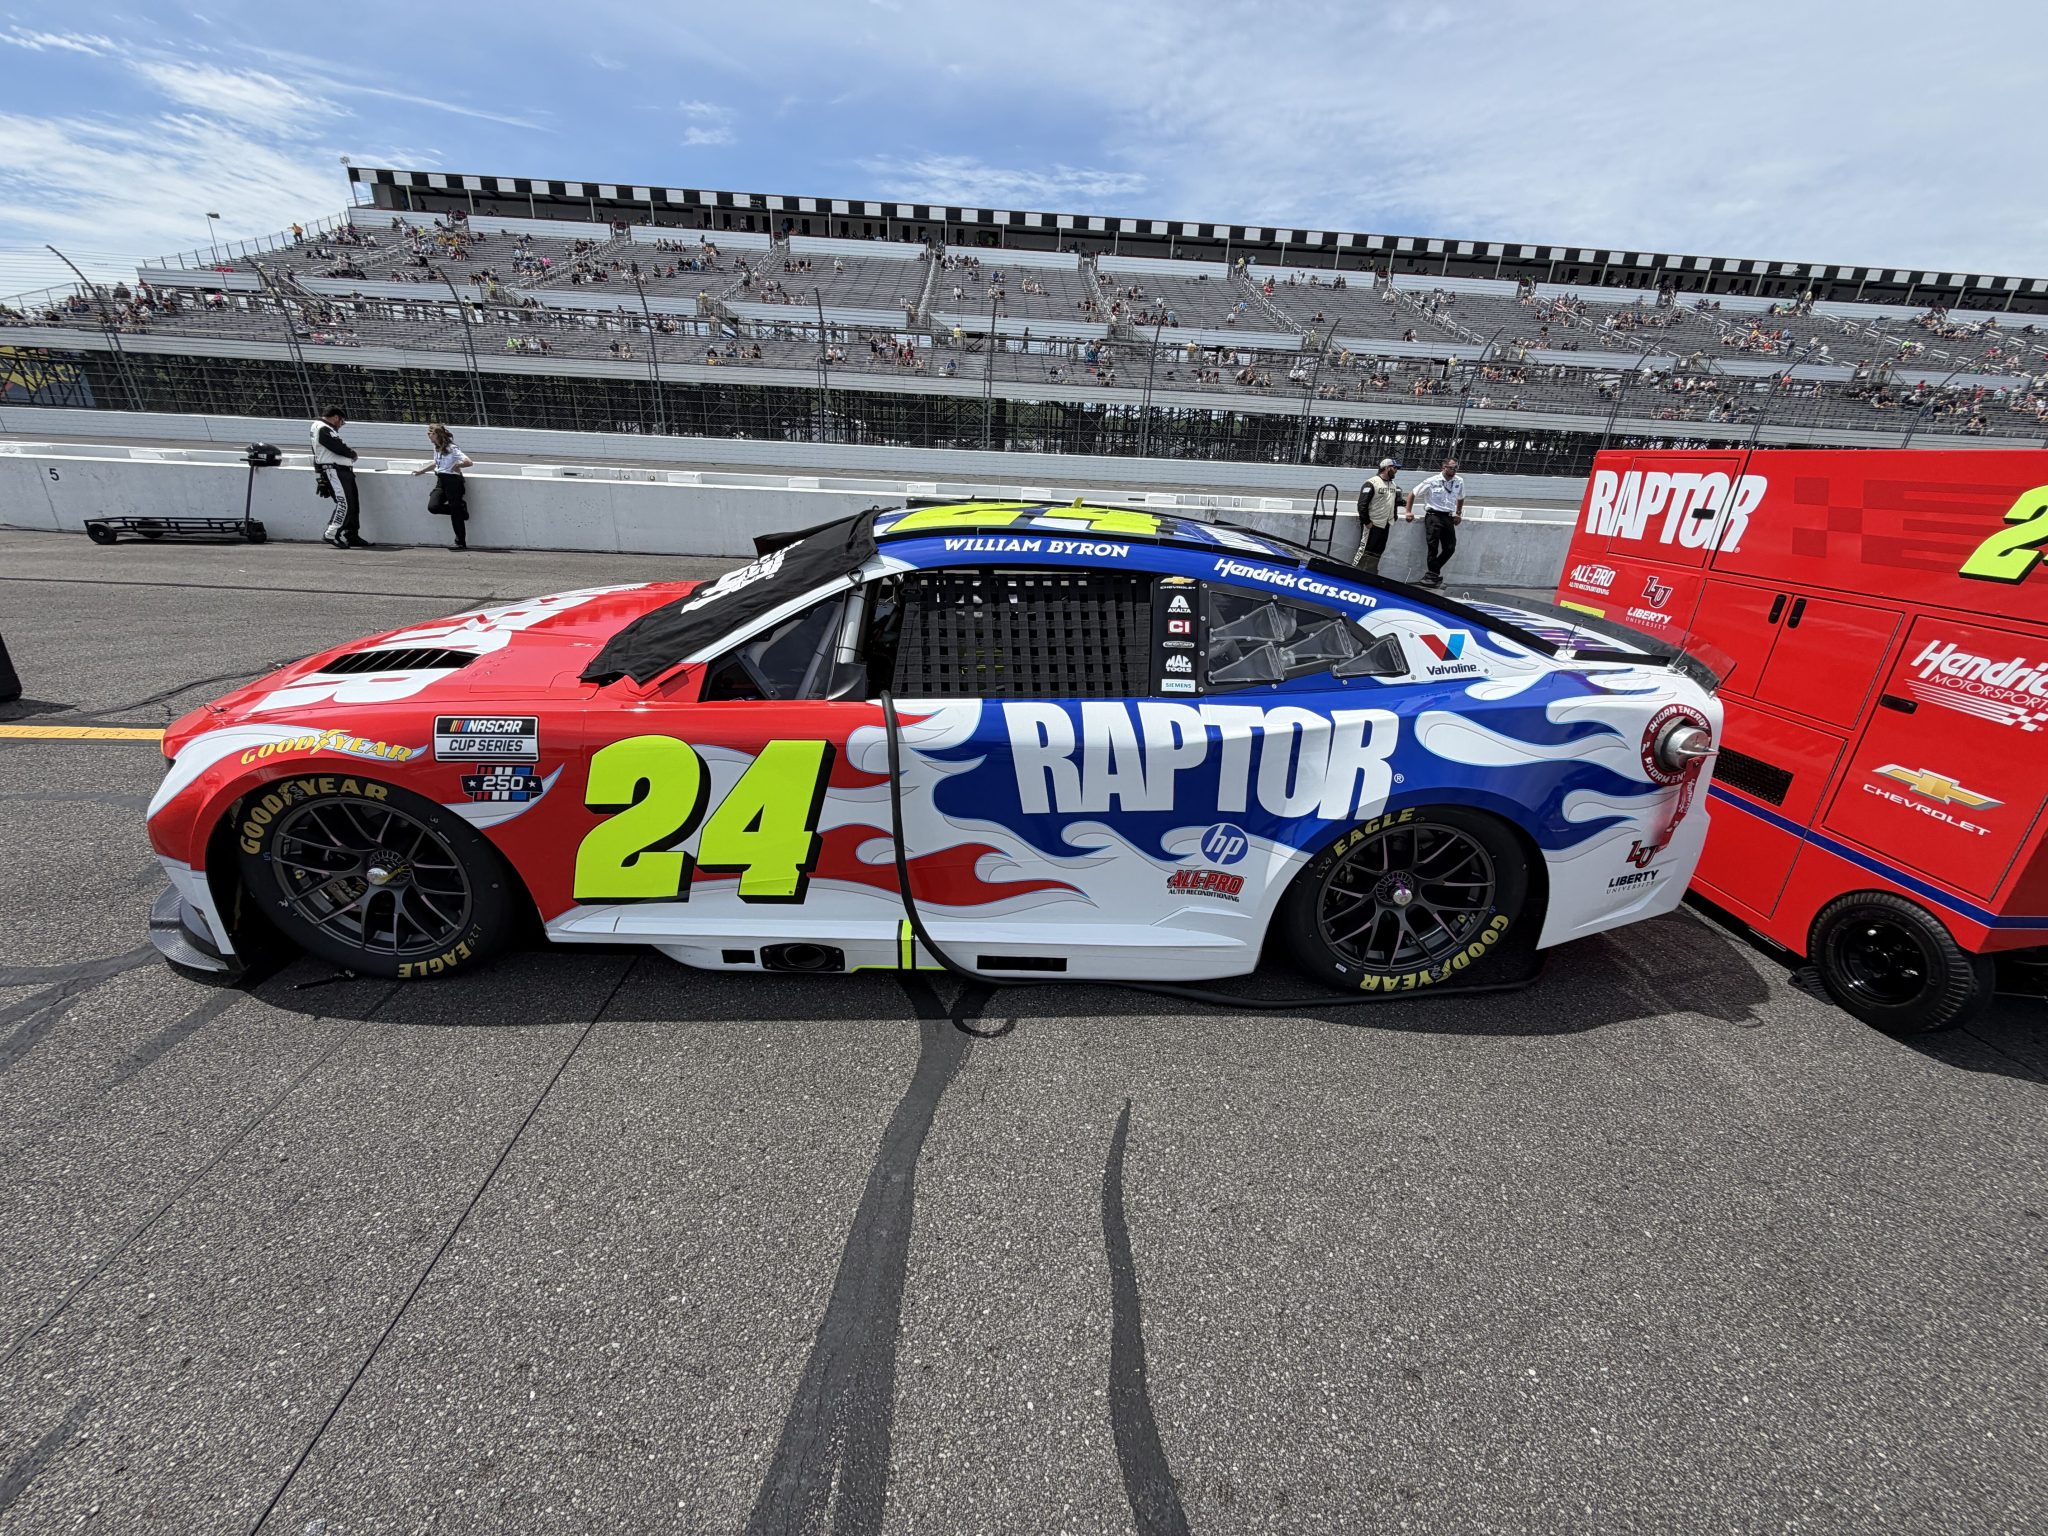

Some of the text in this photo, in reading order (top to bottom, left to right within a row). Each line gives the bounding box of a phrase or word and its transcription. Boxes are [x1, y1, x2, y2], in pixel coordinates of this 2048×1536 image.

[48, 467, 60, 481] 5
[333, 495, 347, 526] OFFICIAL
[1585, 470, 1768, 553] RAPTOR
[1958, 484, 2048, 586] 2
[944, 539, 1130, 558] WILLIAM BYRON
[1569, 564, 1617, 588] ALL-PRO
[1625, 616, 1668, 631] UNIVERSITY
[1626, 606, 1673, 625] LIBERTY
[1165, 654, 1192, 668] MAC
[1426, 663, 1477, 676] Valvoline
[1910, 639, 2048, 698] Hendric
[1929, 674, 2048, 711] MOTORSPORT
[467, 720, 523, 733] NASCAR
[1648, 705, 1678, 734] PHORM
[449, 739, 524, 752] CUP SERIES
[1001, 702, 1399, 820] RAPTOR
[482, 775, 524, 791] 250
[573, 734, 837, 906] 24
[1862, 783, 1992, 836] CHEVROLET
[1332, 807, 1416, 857] EAGLE
[1167, 870, 1245, 896] ALL-PRO
[1606, 881, 1655, 895] UNIVERSITY
[1607, 869, 1660, 889] LIBERTY
[1185, 889, 1241, 903] RECONDITIONING
[397, 941, 472, 978] EAGLE
